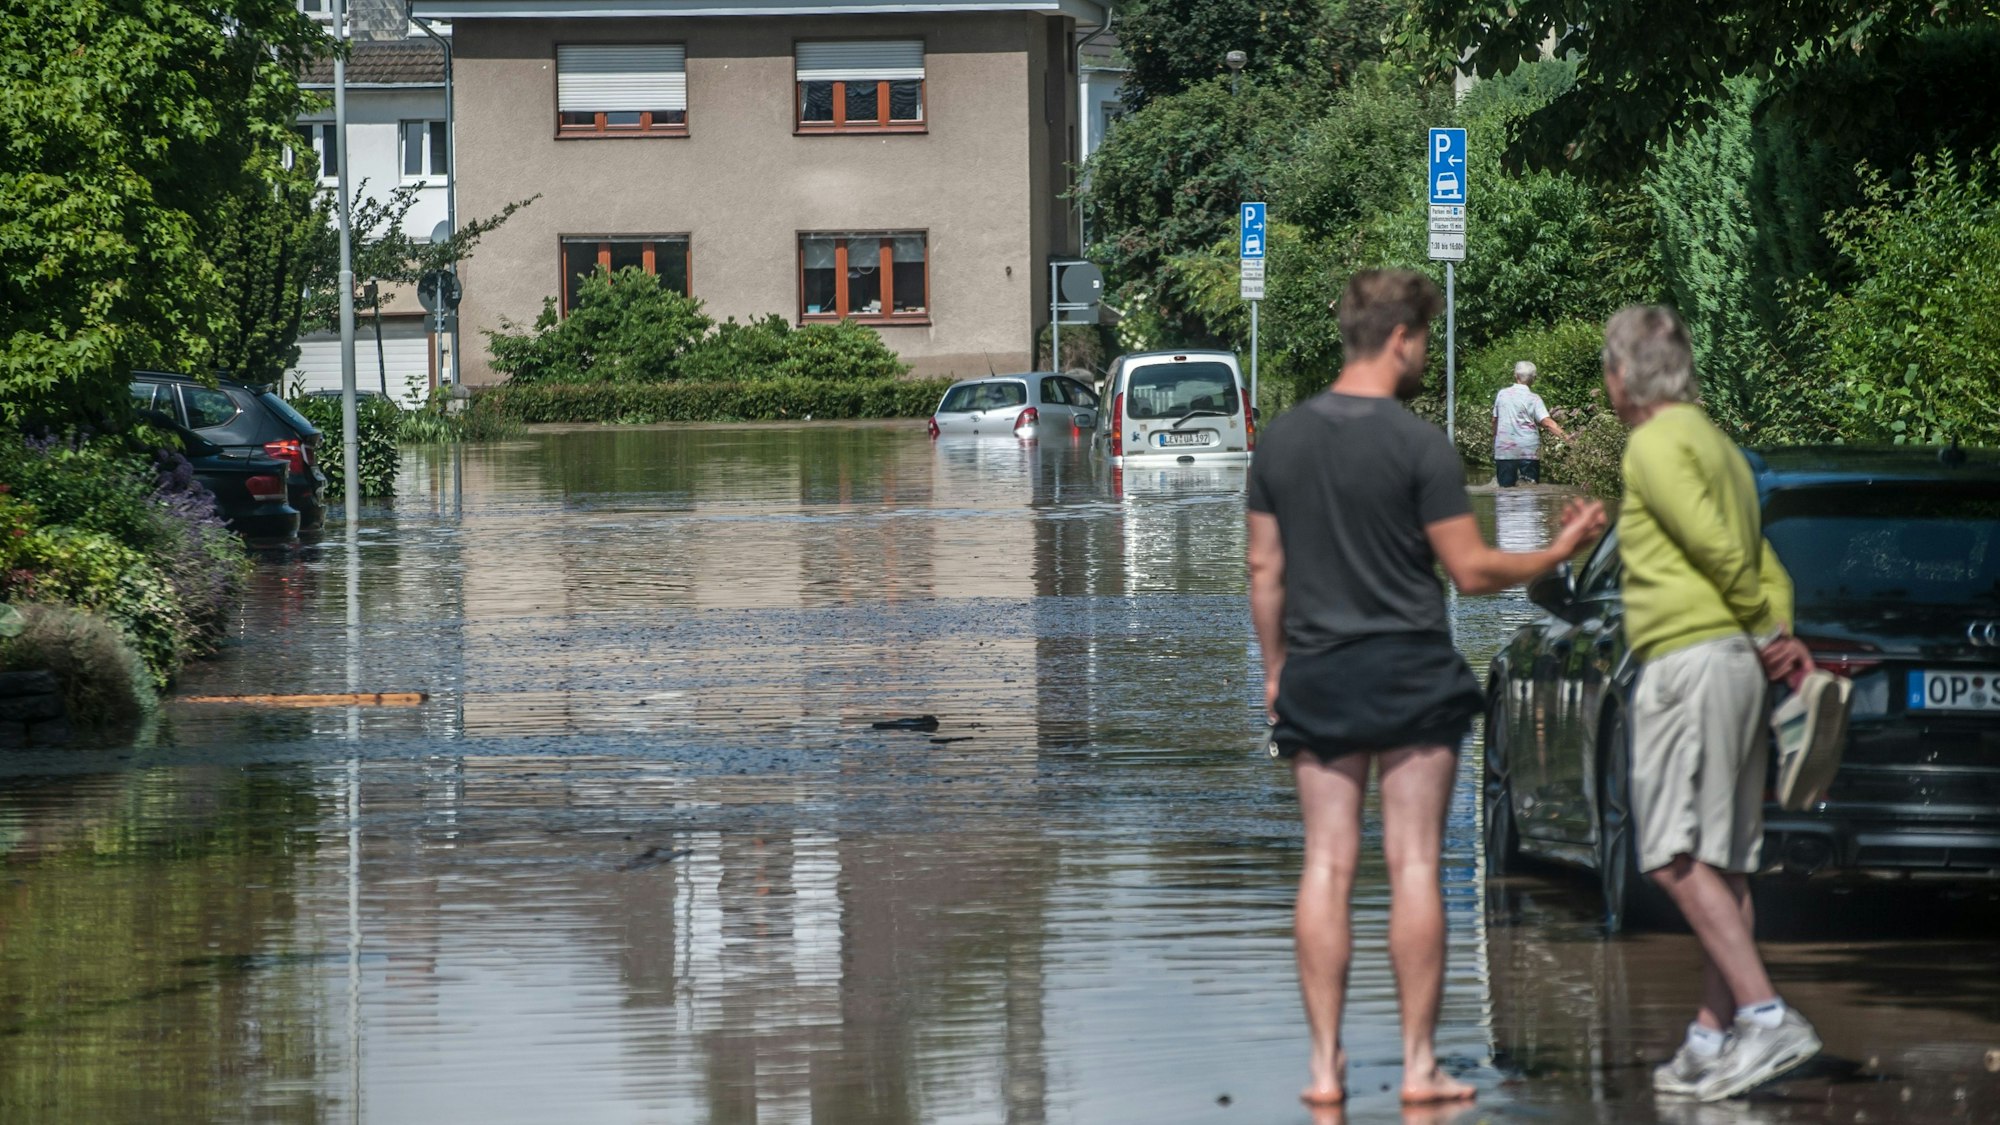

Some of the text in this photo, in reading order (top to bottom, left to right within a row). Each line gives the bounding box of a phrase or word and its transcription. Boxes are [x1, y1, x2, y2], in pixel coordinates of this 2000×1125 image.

[1435, 134, 1451, 163] P
[1245, 206, 1256, 228] P
[1441, 242, 1449, 250] bis
[1164, 434, 1178, 444] LEV
[1195, 433, 1209, 443] 197
[1928, 676, 1969, 706] OP
